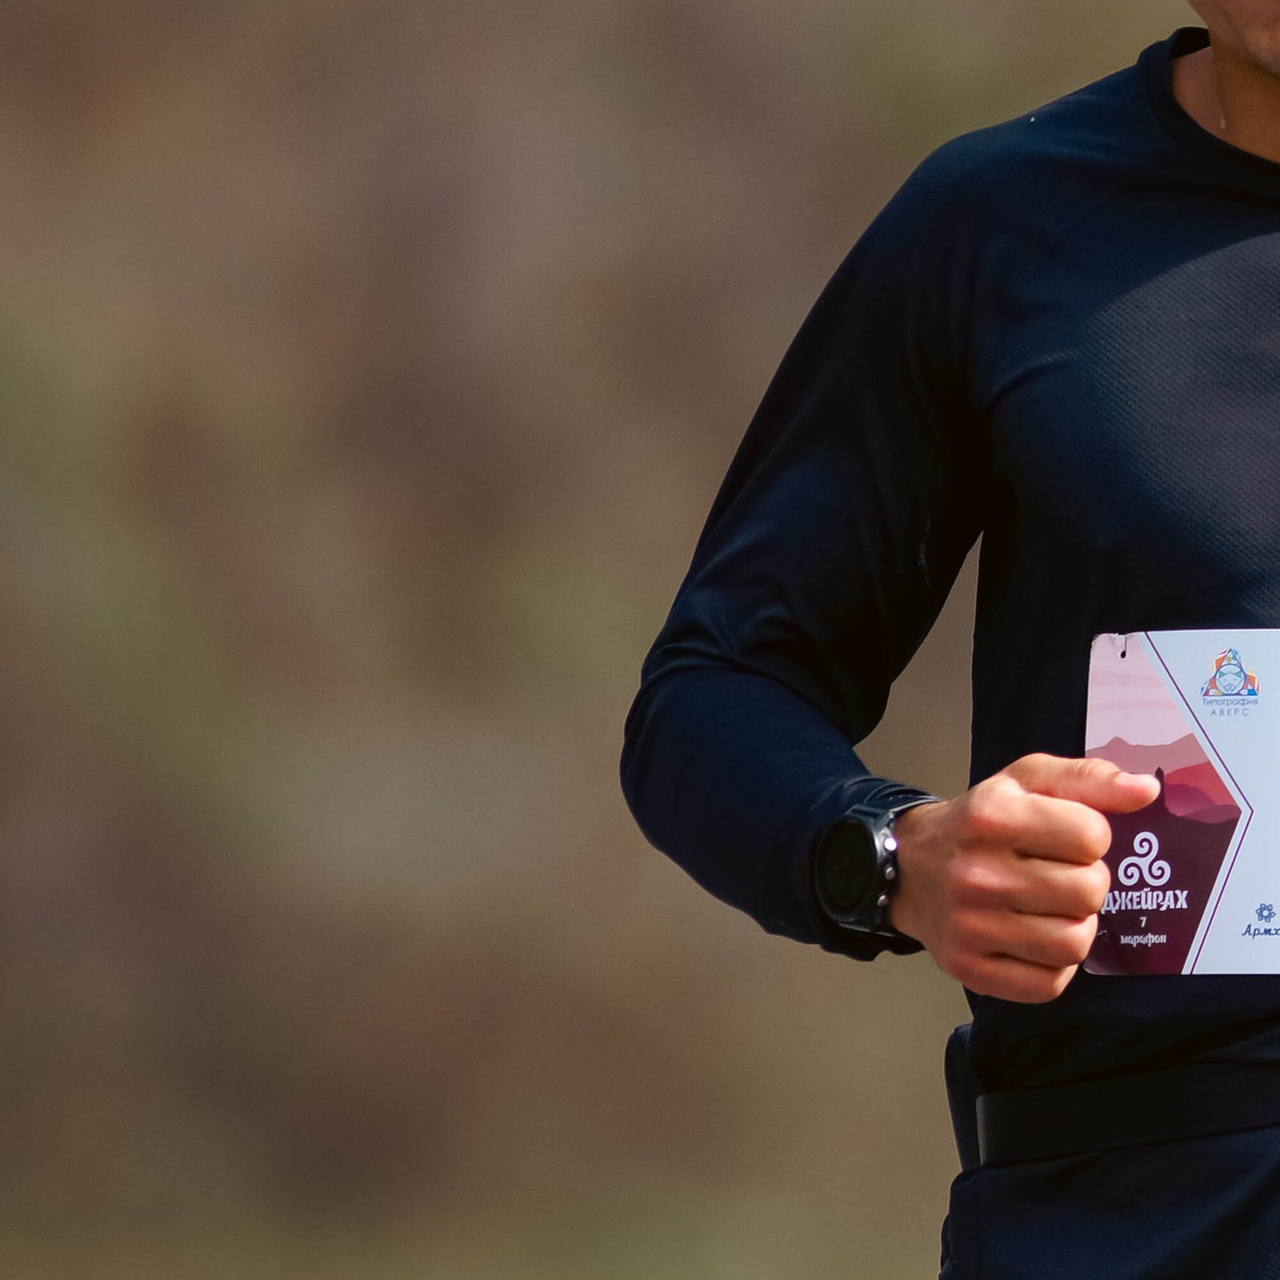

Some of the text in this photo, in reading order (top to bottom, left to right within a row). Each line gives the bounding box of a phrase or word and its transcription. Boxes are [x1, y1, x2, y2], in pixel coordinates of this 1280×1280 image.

[1101, 887, 1189, 914] ДЖЕЙРАХ
[1139, 916, 1147, 928] 7
[1120, 933, 1167, 947] марафон
